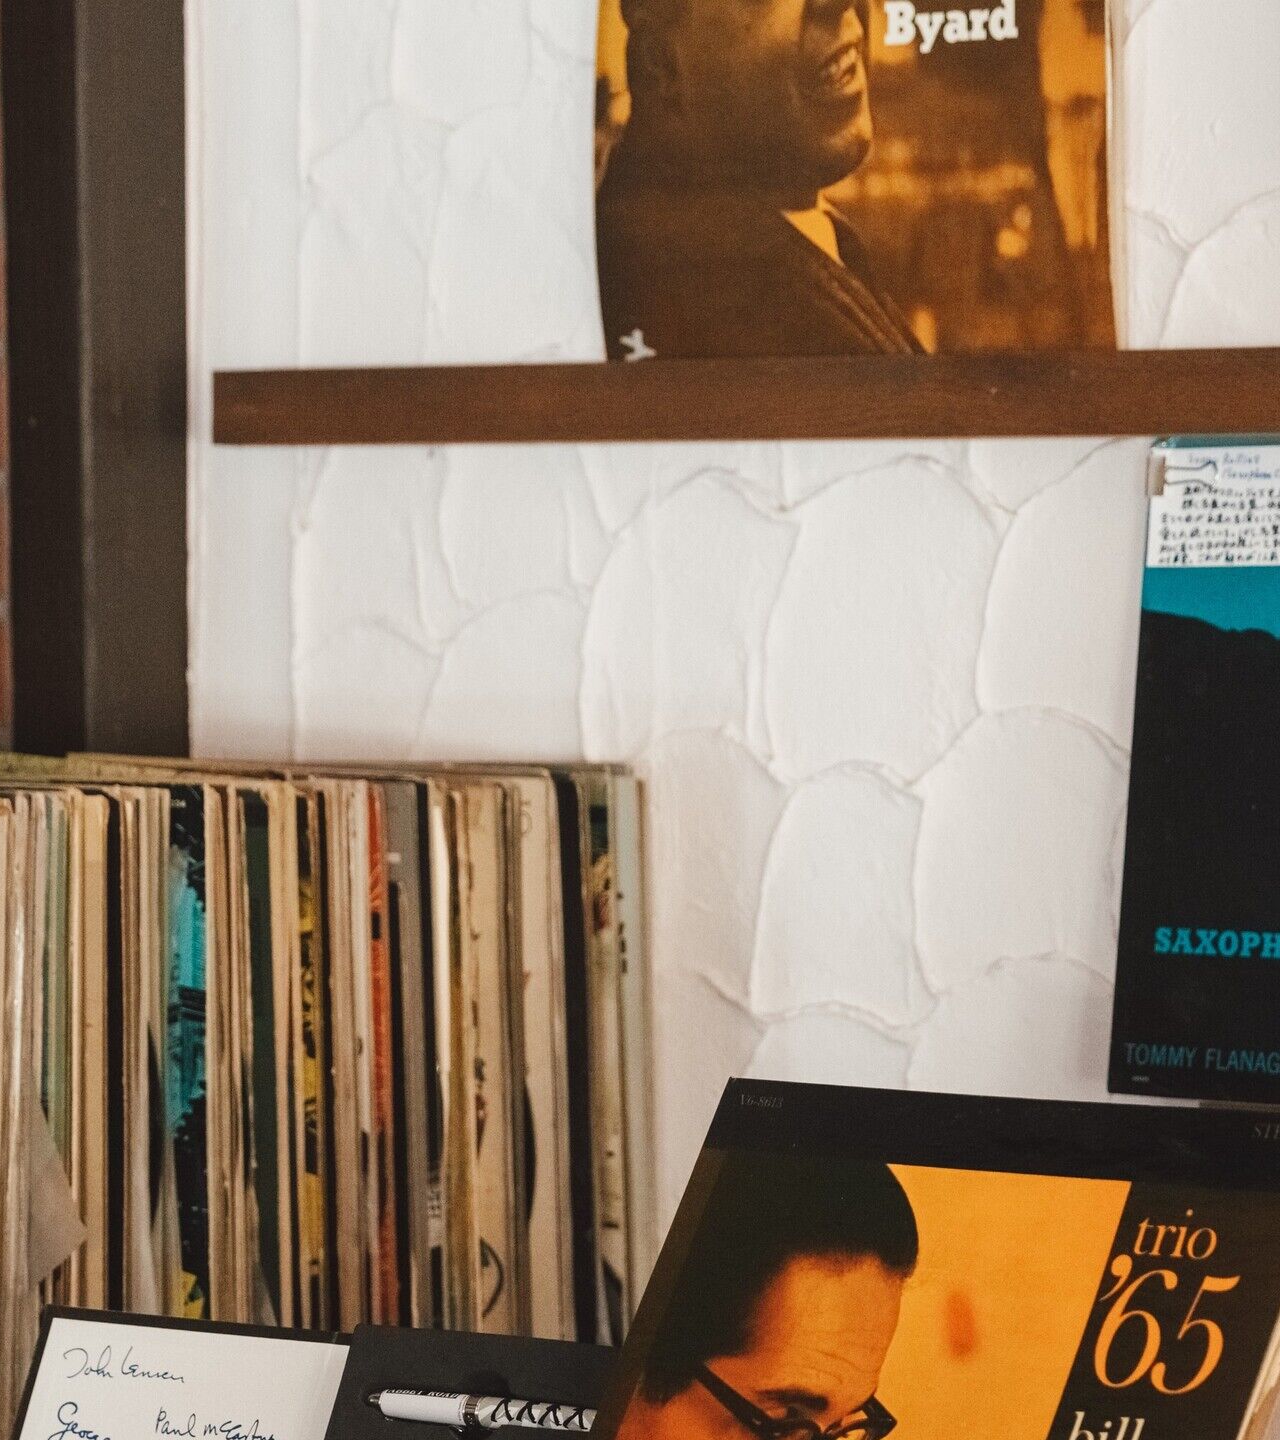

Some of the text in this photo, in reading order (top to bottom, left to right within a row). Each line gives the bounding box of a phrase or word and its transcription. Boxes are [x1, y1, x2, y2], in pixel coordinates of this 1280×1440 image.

[883, 0, 1019, 54] Byard
[1124, 1042, 1197, 1068] TOMMY
[1133, 1209, 1218, 1260] trio
[63, 1345, 113, 1379] John
[155, 1406, 196, 1438] Paul
